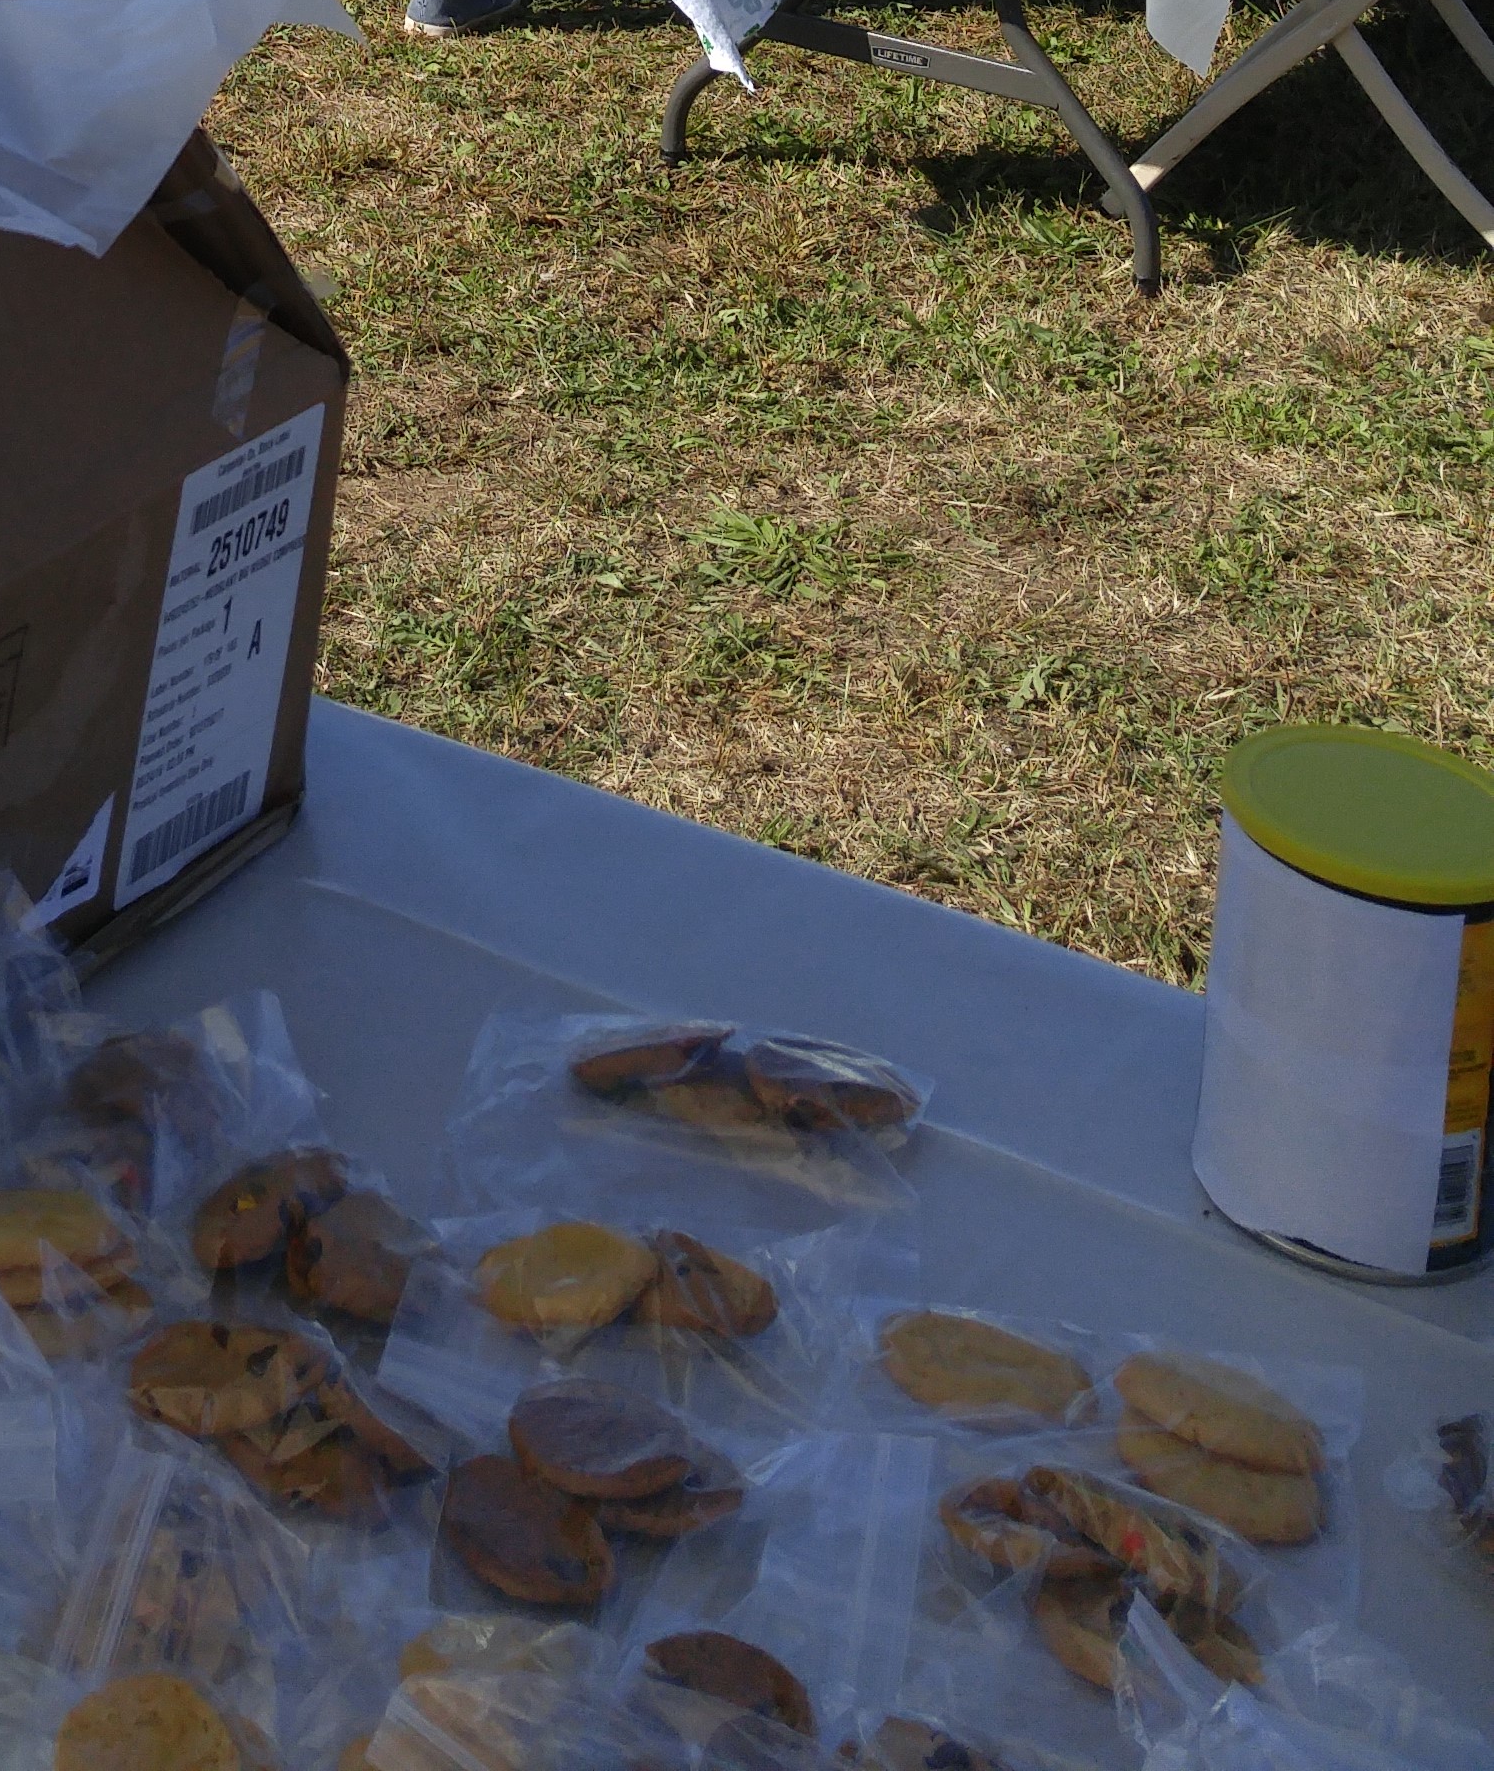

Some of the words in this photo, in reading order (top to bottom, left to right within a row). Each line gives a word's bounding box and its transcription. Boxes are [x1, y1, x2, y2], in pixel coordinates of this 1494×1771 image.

[877, 48, 923, 65] LIFETIME
[207, 498, 290, 578] 2510749
[222, 595, 233, 635] 1
[247, 618, 264, 660] A
